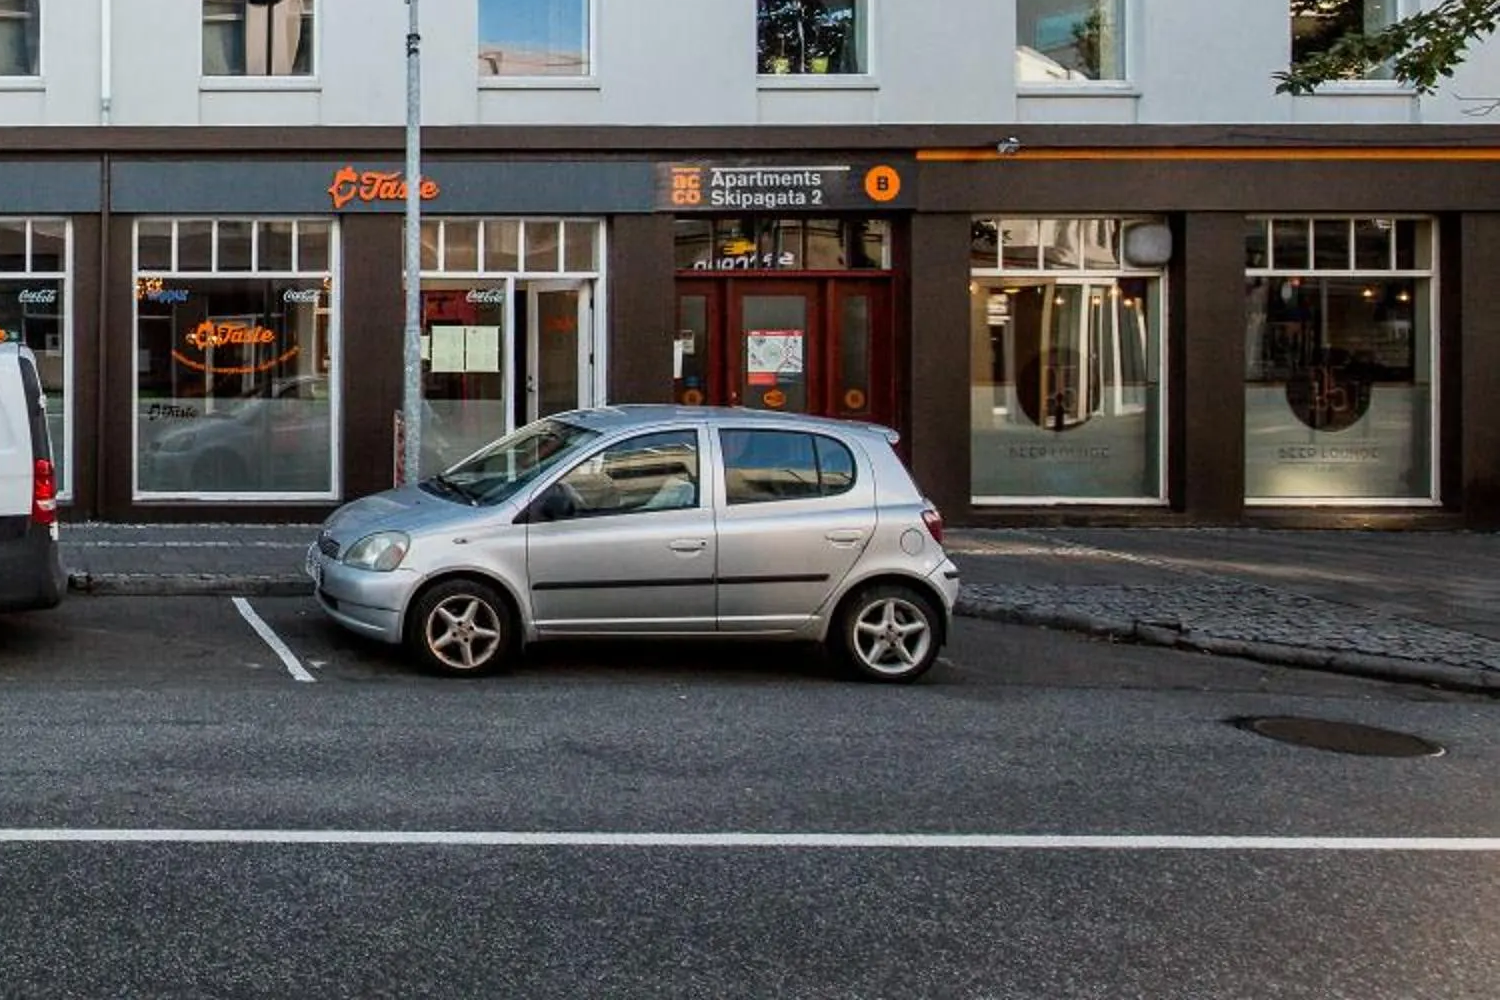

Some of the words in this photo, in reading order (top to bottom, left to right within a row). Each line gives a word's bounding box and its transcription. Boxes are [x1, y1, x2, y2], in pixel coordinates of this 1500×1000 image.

[711, 171, 822, 191] Apartments
[876, 176, 889, 191] B
[711, 189, 806, 208] Skipagata
[811, 189, 823, 205] 2
